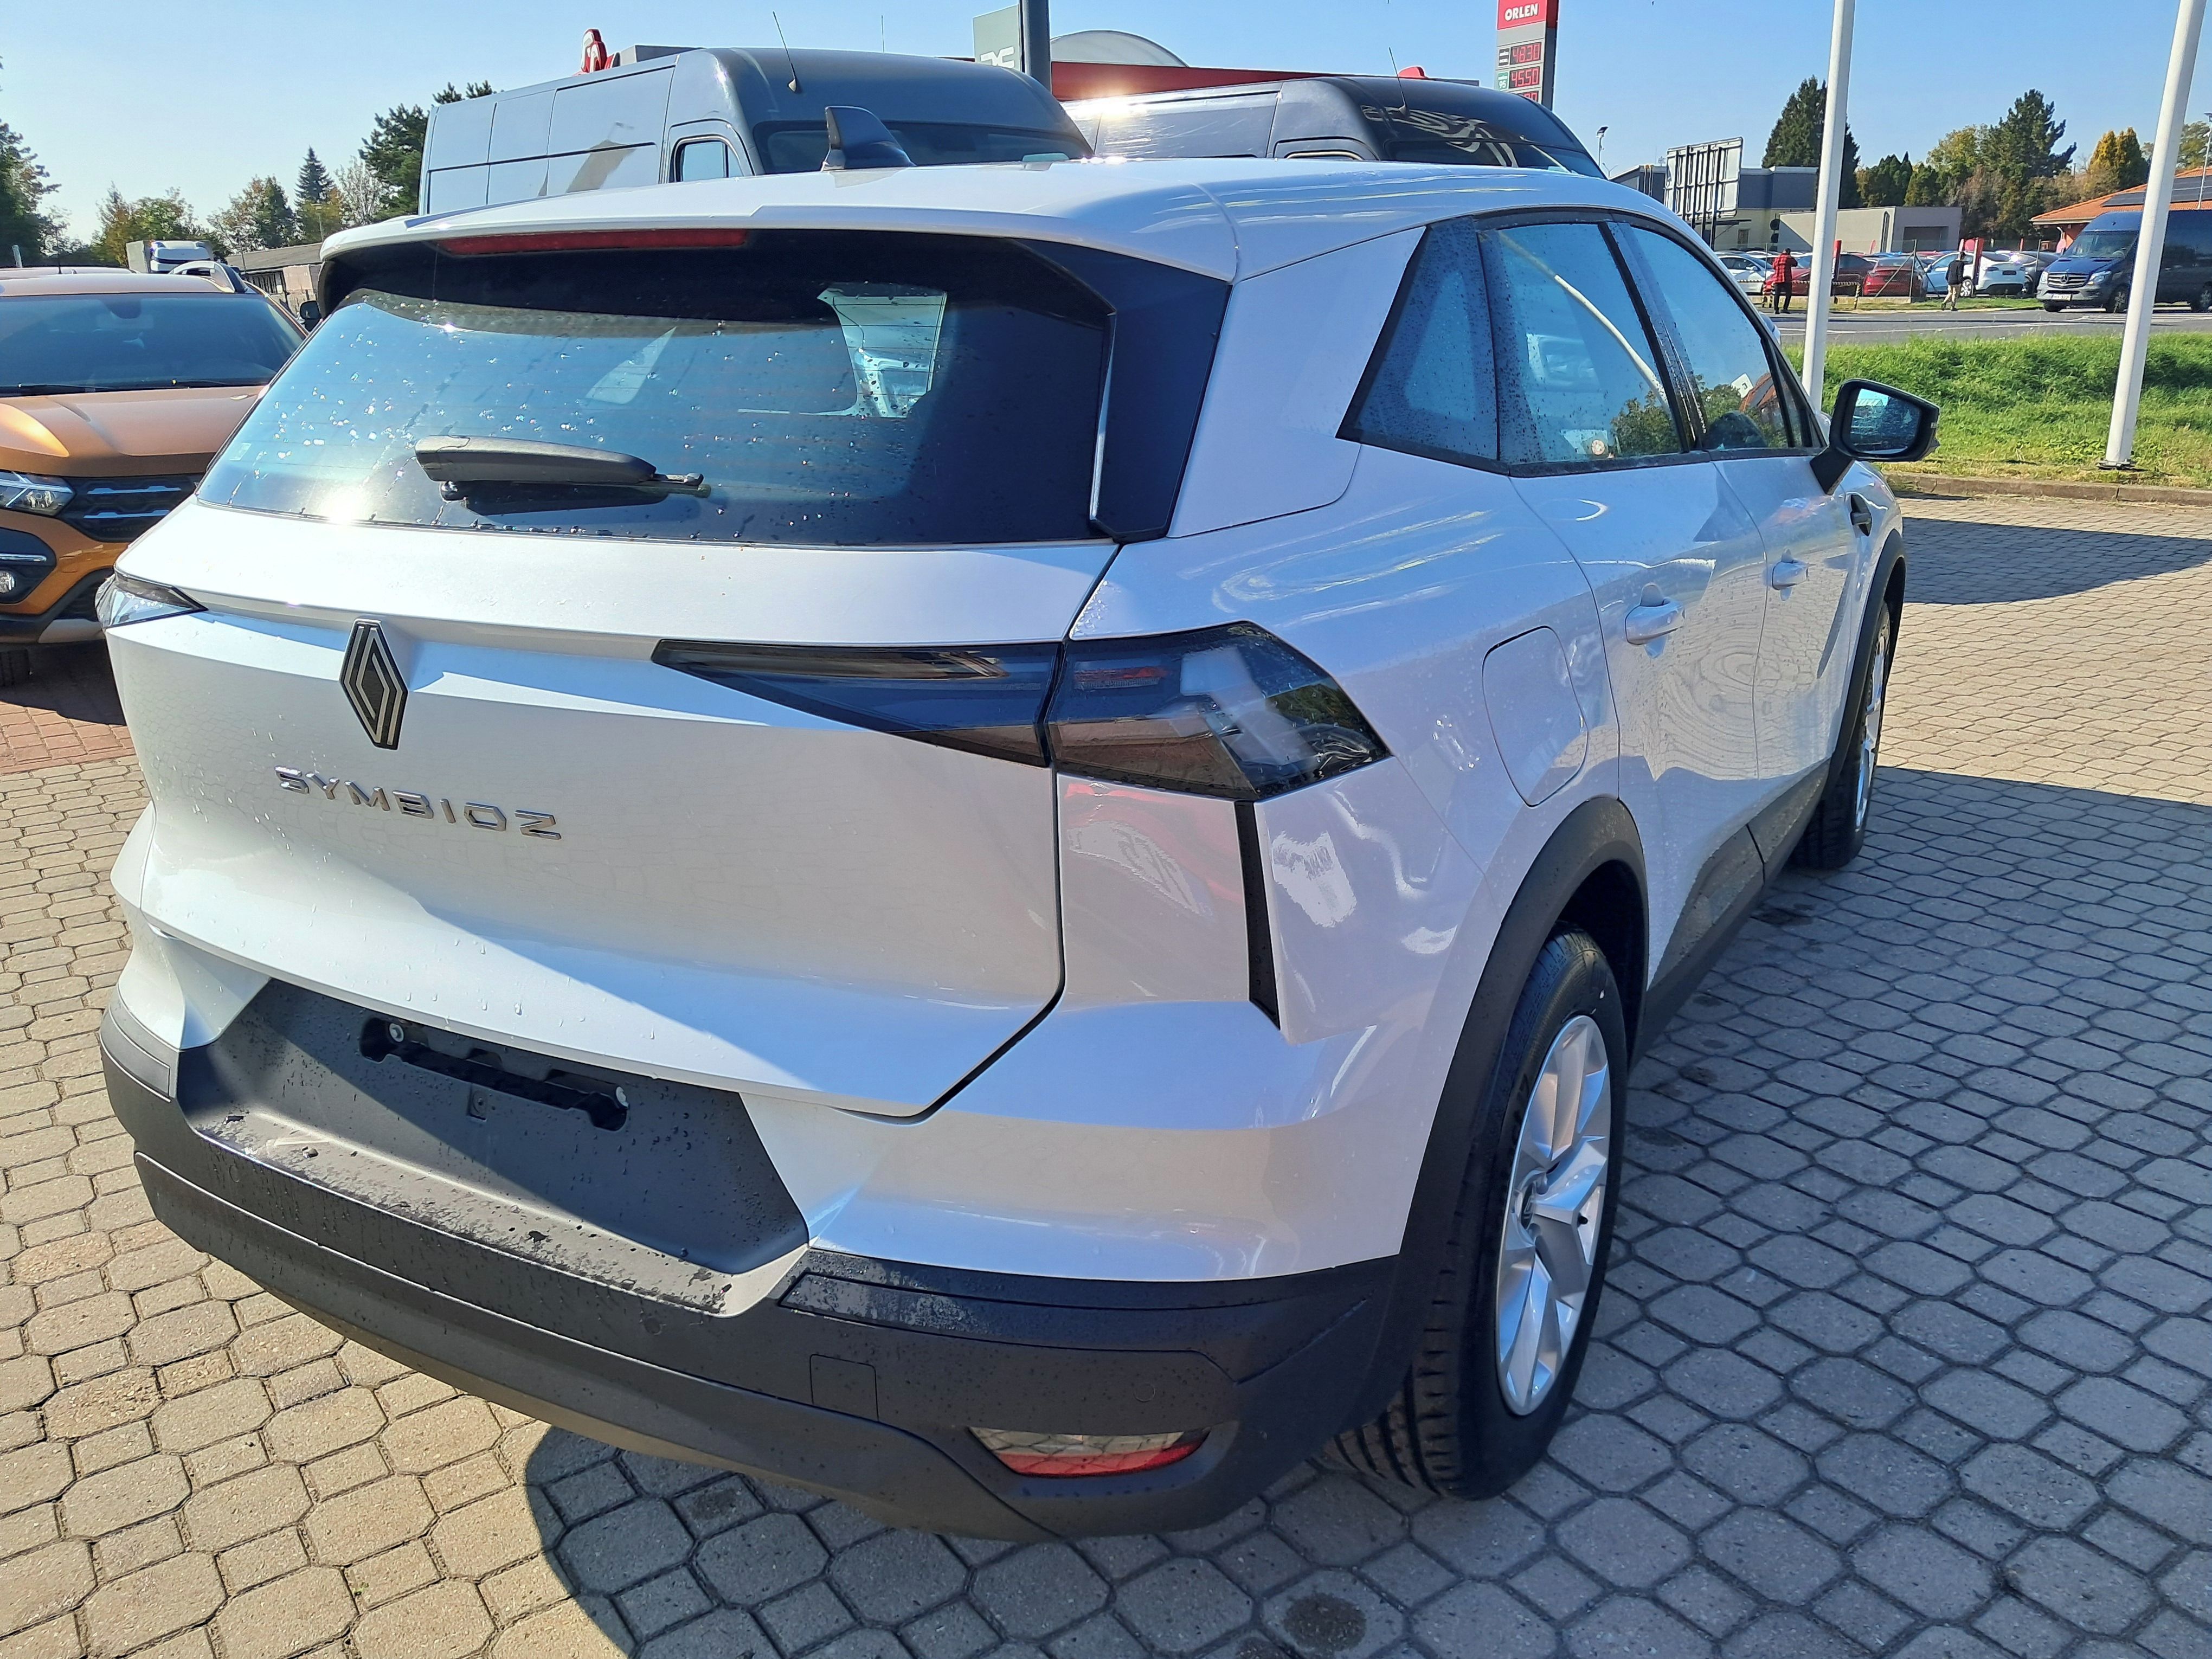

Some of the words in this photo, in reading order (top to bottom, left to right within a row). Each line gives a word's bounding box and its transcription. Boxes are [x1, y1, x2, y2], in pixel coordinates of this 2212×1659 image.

[1504, 3, 1539, 22] ORLEN
[1499, 80, 1507, 89] 95
[273, 765, 562, 840] SYMBIOZ
